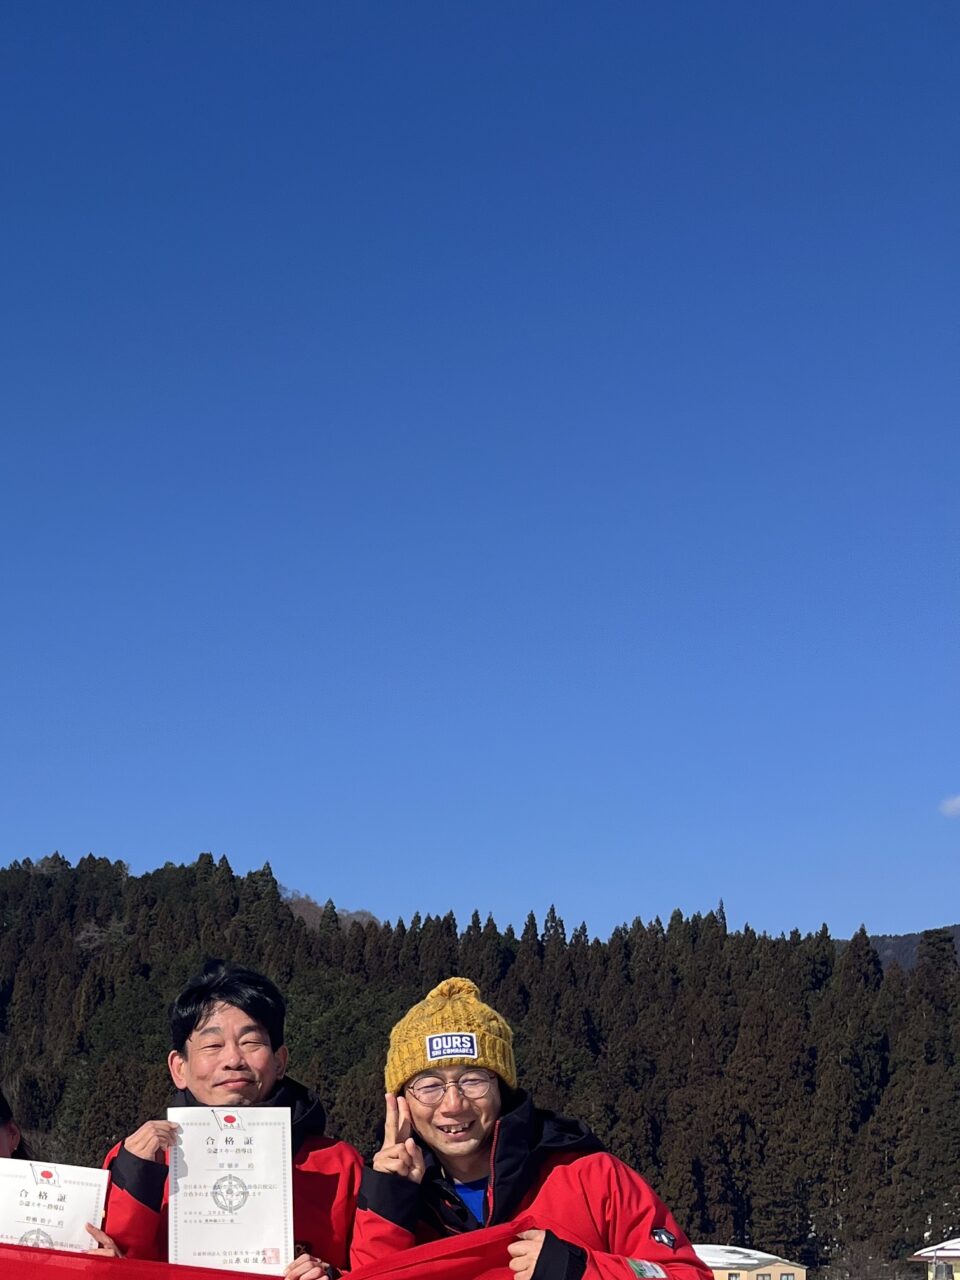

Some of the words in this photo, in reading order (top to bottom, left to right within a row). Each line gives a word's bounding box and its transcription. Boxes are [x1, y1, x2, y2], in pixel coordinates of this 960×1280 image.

[432, 1036, 471, 1050] OURS
[206, 1136, 254, 1146] 合格証
